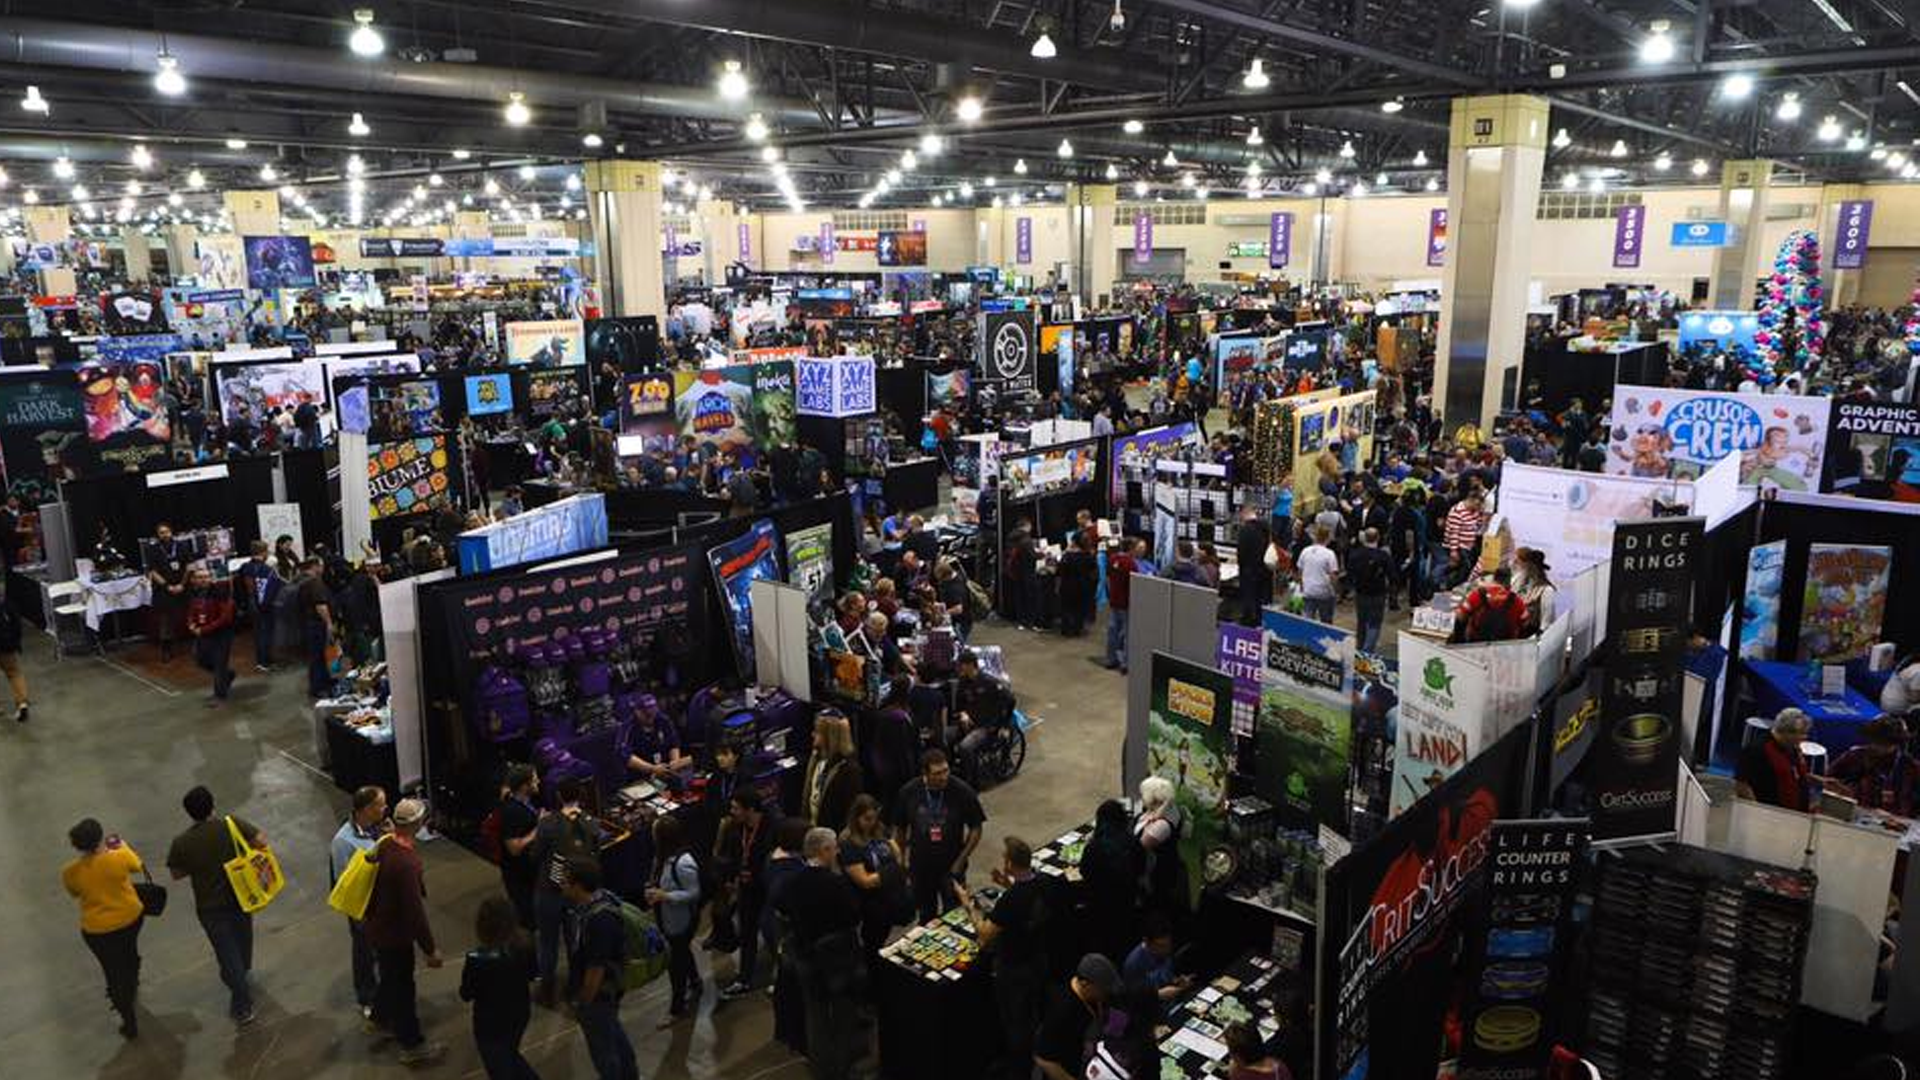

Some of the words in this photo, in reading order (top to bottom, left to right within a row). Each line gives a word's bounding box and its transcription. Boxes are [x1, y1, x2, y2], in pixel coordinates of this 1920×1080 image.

[801, 363, 831, 381] XYZ
[842, 362, 872, 381] XYZ
[801, 382, 831, 396] GAME
[842, 382, 872, 396] GAME
[18, 399, 60, 415] DARK
[801, 397, 831, 412] LABS
[842, 396, 872, 411] LABS
[1678, 399, 1751, 423] CRUSOE
[7, 407, 75, 425] HARVEST
[1840, 404, 1917, 421] GRAPHIC
[1667, 420, 1761, 459] CREW
[1625, 532, 1691, 550] DICE
[1623, 552, 1686, 571] RINGS
[1498, 832, 1576, 847] LIFE
[1496, 850, 1571, 866] COUNTER
[1494, 869, 1569, 885] RINGS
